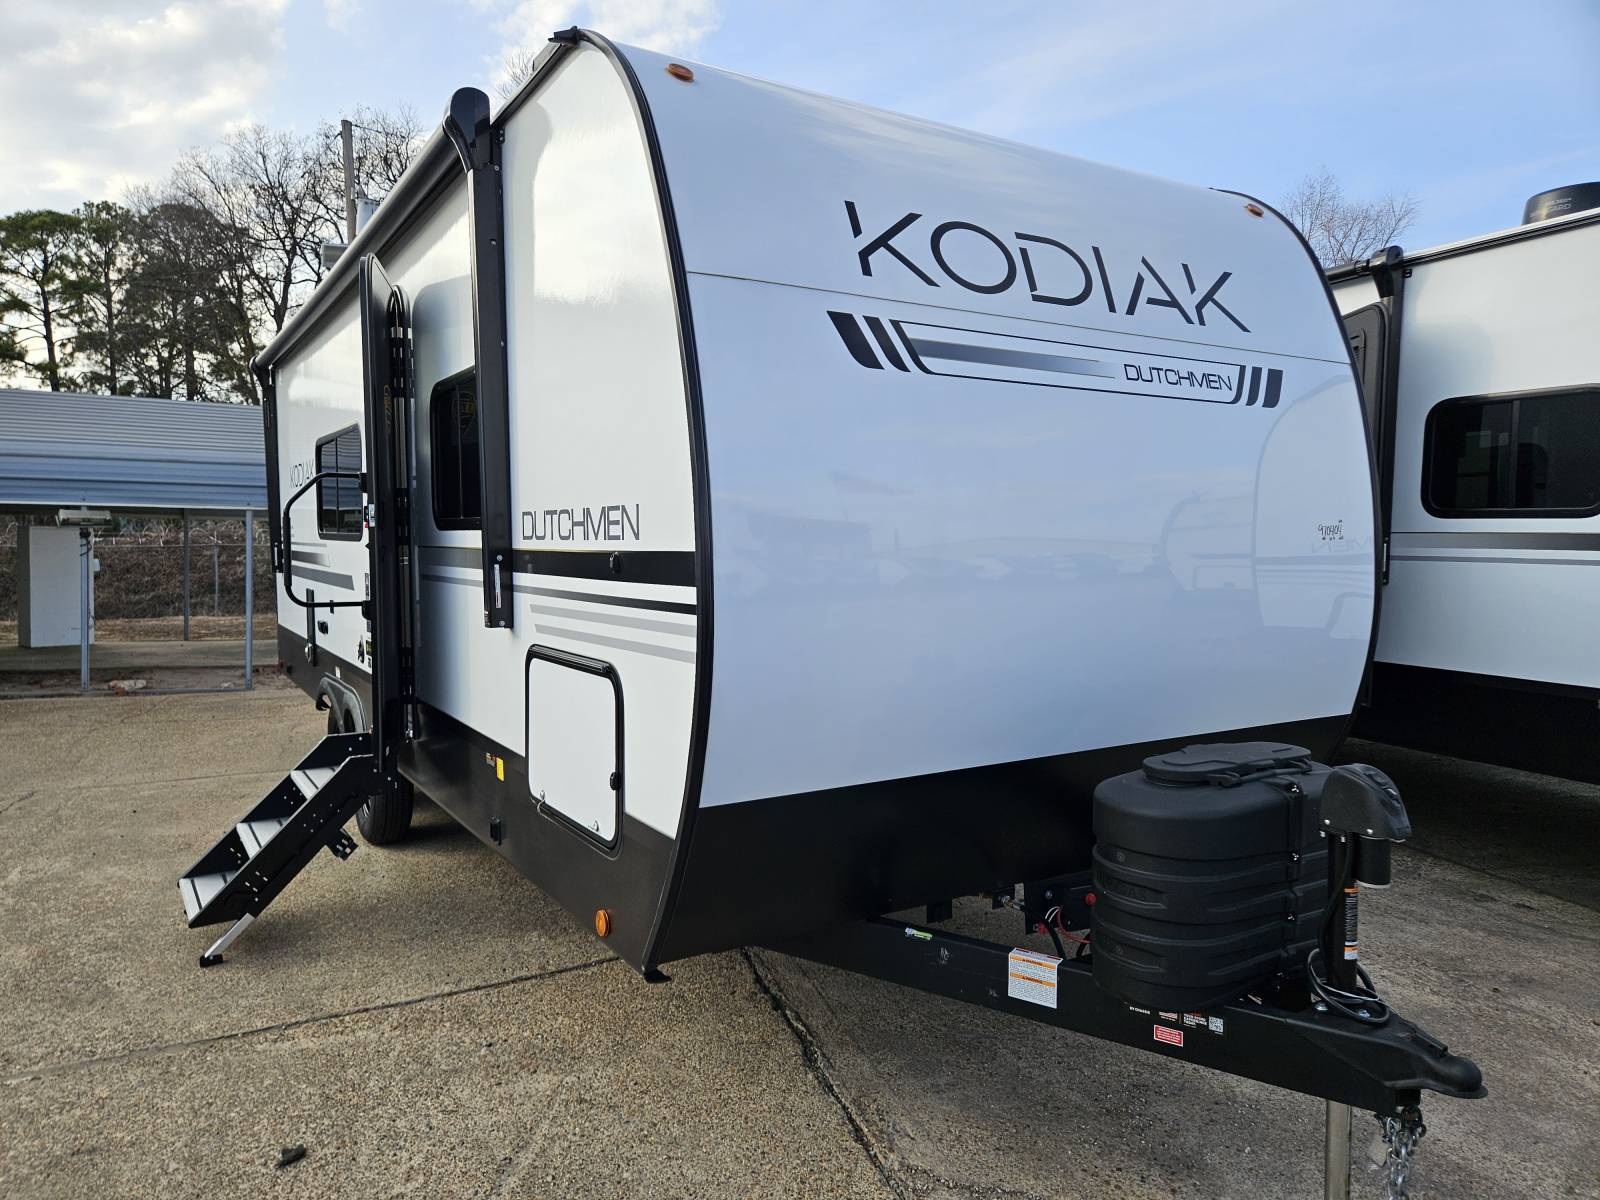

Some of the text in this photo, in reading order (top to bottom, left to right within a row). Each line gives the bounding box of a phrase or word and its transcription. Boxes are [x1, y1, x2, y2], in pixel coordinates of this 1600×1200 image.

[844, 200, 1251, 333] KODIAK
[1124, 363, 1233, 391] DUTCHMEN
[522, 504, 640, 541] DUTCHMEN
